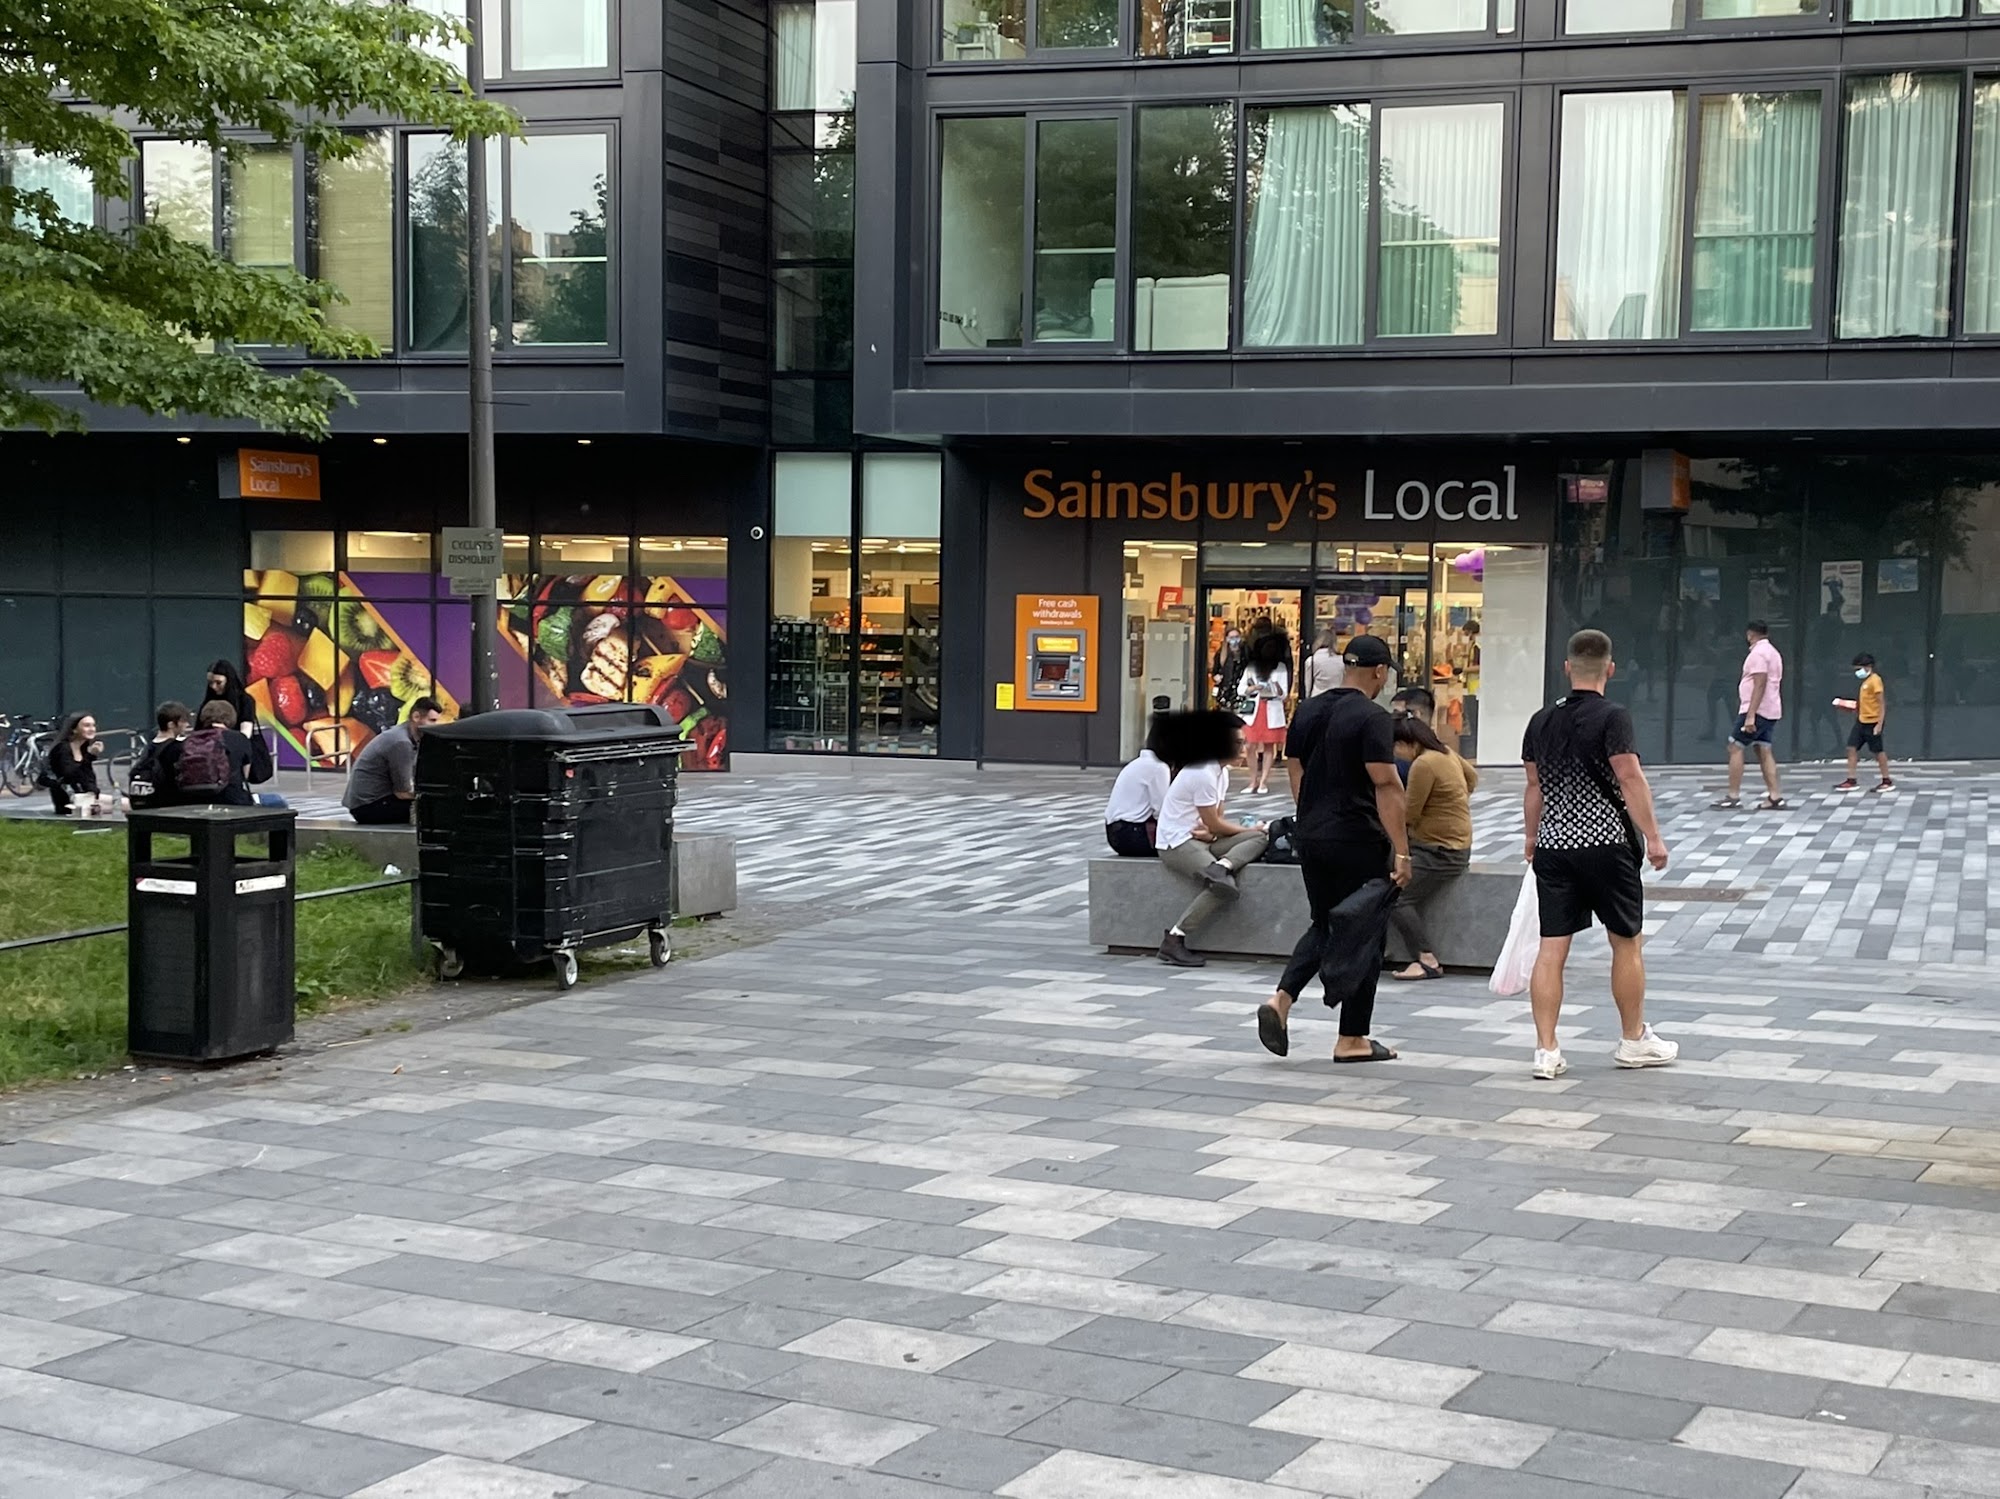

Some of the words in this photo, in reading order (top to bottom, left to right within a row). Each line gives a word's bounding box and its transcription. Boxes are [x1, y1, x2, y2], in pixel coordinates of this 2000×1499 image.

[249, 457, 313, 478] Sainsbury's
[249, 476, 280, 492] Local
[1022, 469, 1338, 531] Sainsbury's
[1364, 465, 1519, 521] Local
[451, 540, 494, 551] CYCLISTS
[448, 554, 496, 565] DISMOUNT
[1038, 598, 1056, 608] Free
[1057, 598, 1077, 608] cash
[1032, 609, 1082, 619] withdrawals
